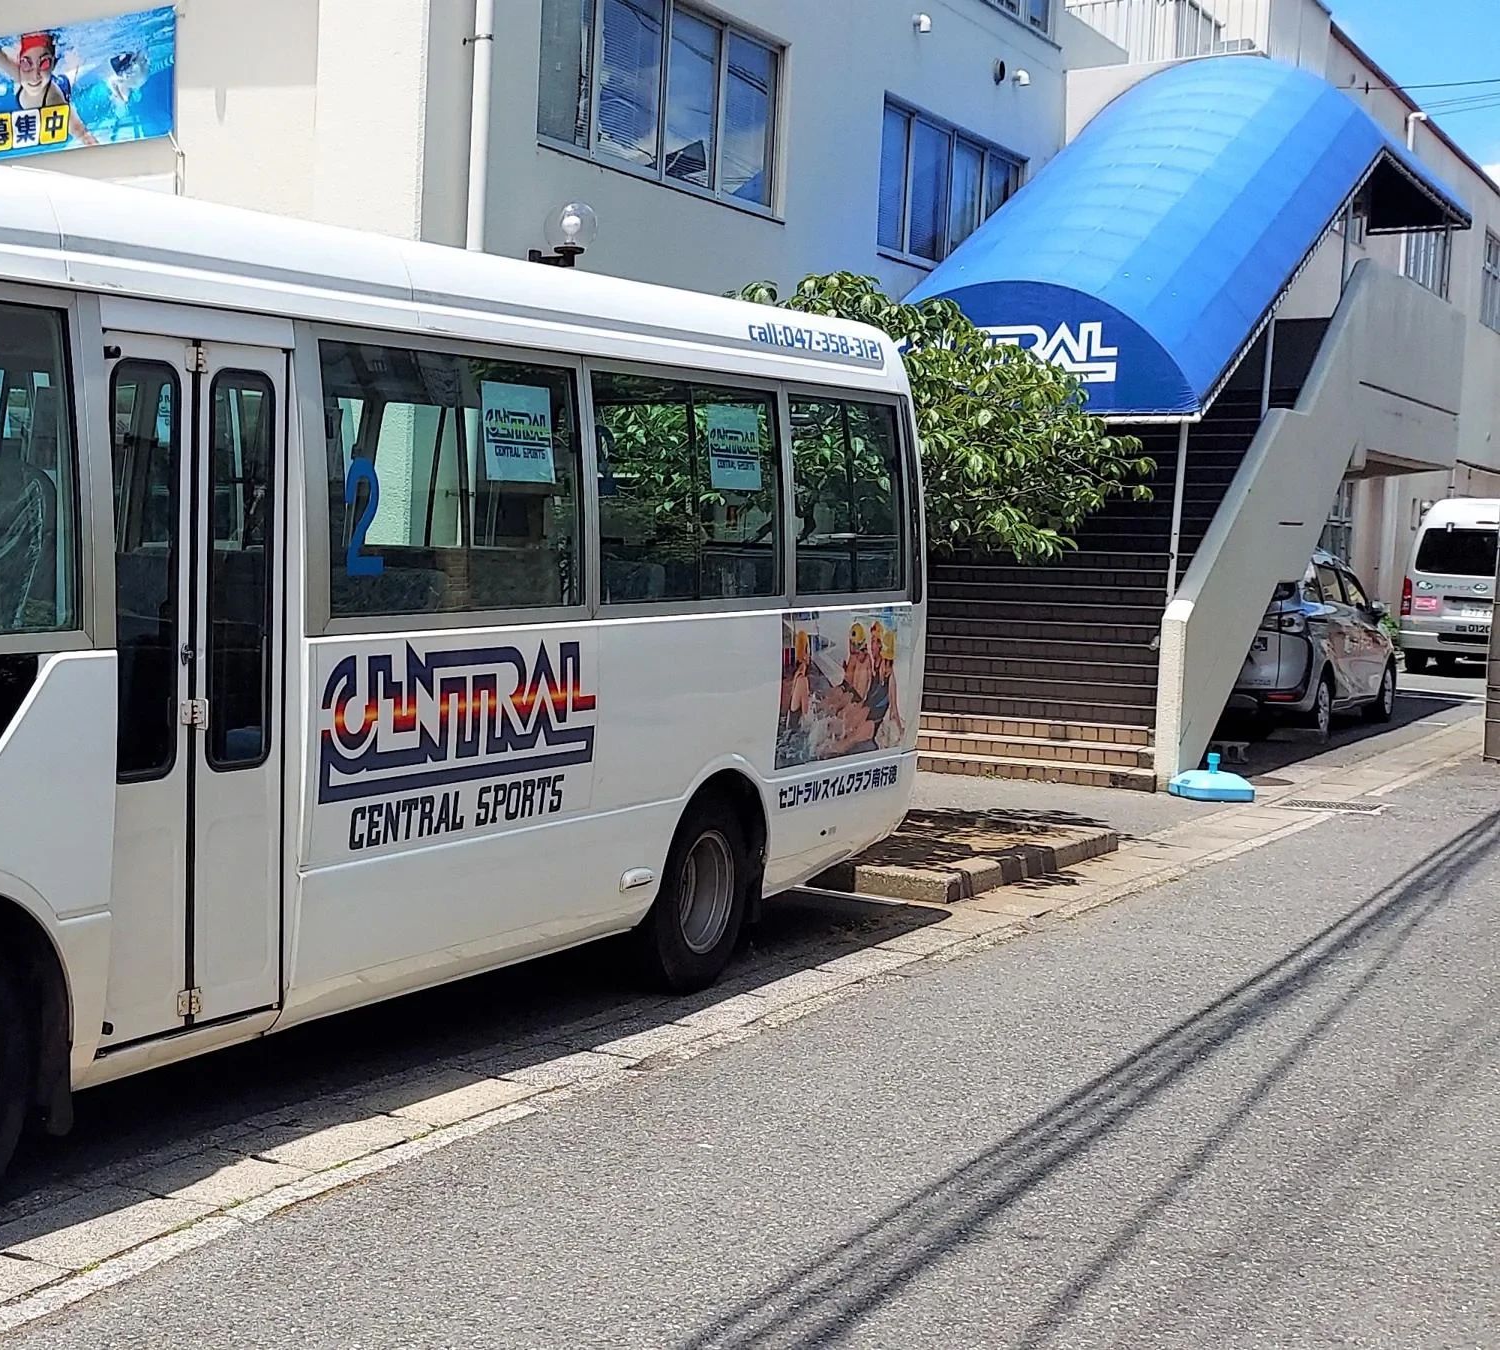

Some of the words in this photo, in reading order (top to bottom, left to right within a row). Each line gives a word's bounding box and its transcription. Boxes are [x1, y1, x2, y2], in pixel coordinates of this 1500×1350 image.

[485, 408, 551, 448] CENTRAL
[495, 445, 521, 458] CENTRAL
[345, 457, 384, 576] 2
[318, 639, 597, 805] CENTRAL
[348, 790, 465, 850] CENTRAL
[475, 774, 565, 827] SPORTS
[778, 764, 898, 809] セントラルスイムクラブ南行徳
